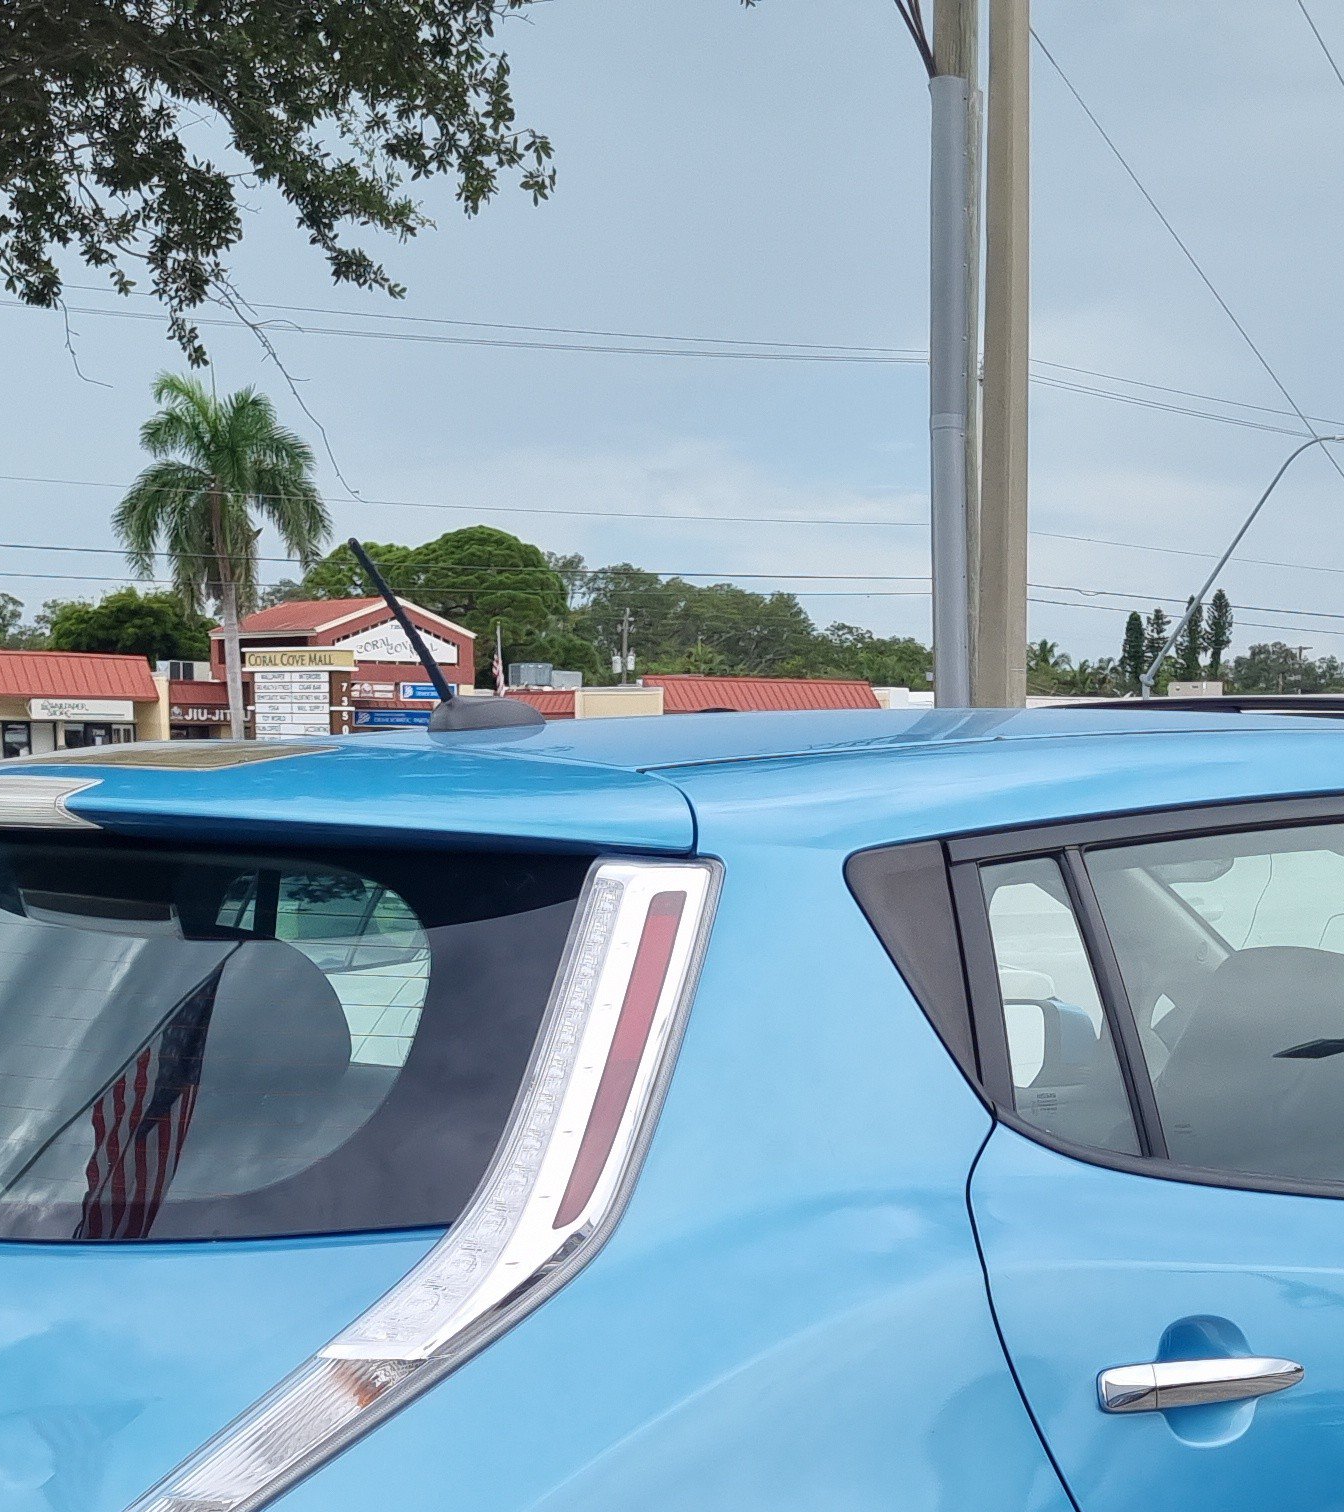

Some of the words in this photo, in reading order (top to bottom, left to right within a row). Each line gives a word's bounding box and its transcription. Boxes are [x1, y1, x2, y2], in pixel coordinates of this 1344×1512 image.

[356, 637, 391, 654] CORAL
[387, 640, 413, 655] COV
[248, 653, 278, 667] CORAL
[280, 653, 307, 666] COVE
[308, 653, 335, 666] MALL
[184, 708, 251, 721] JIU-JITU
